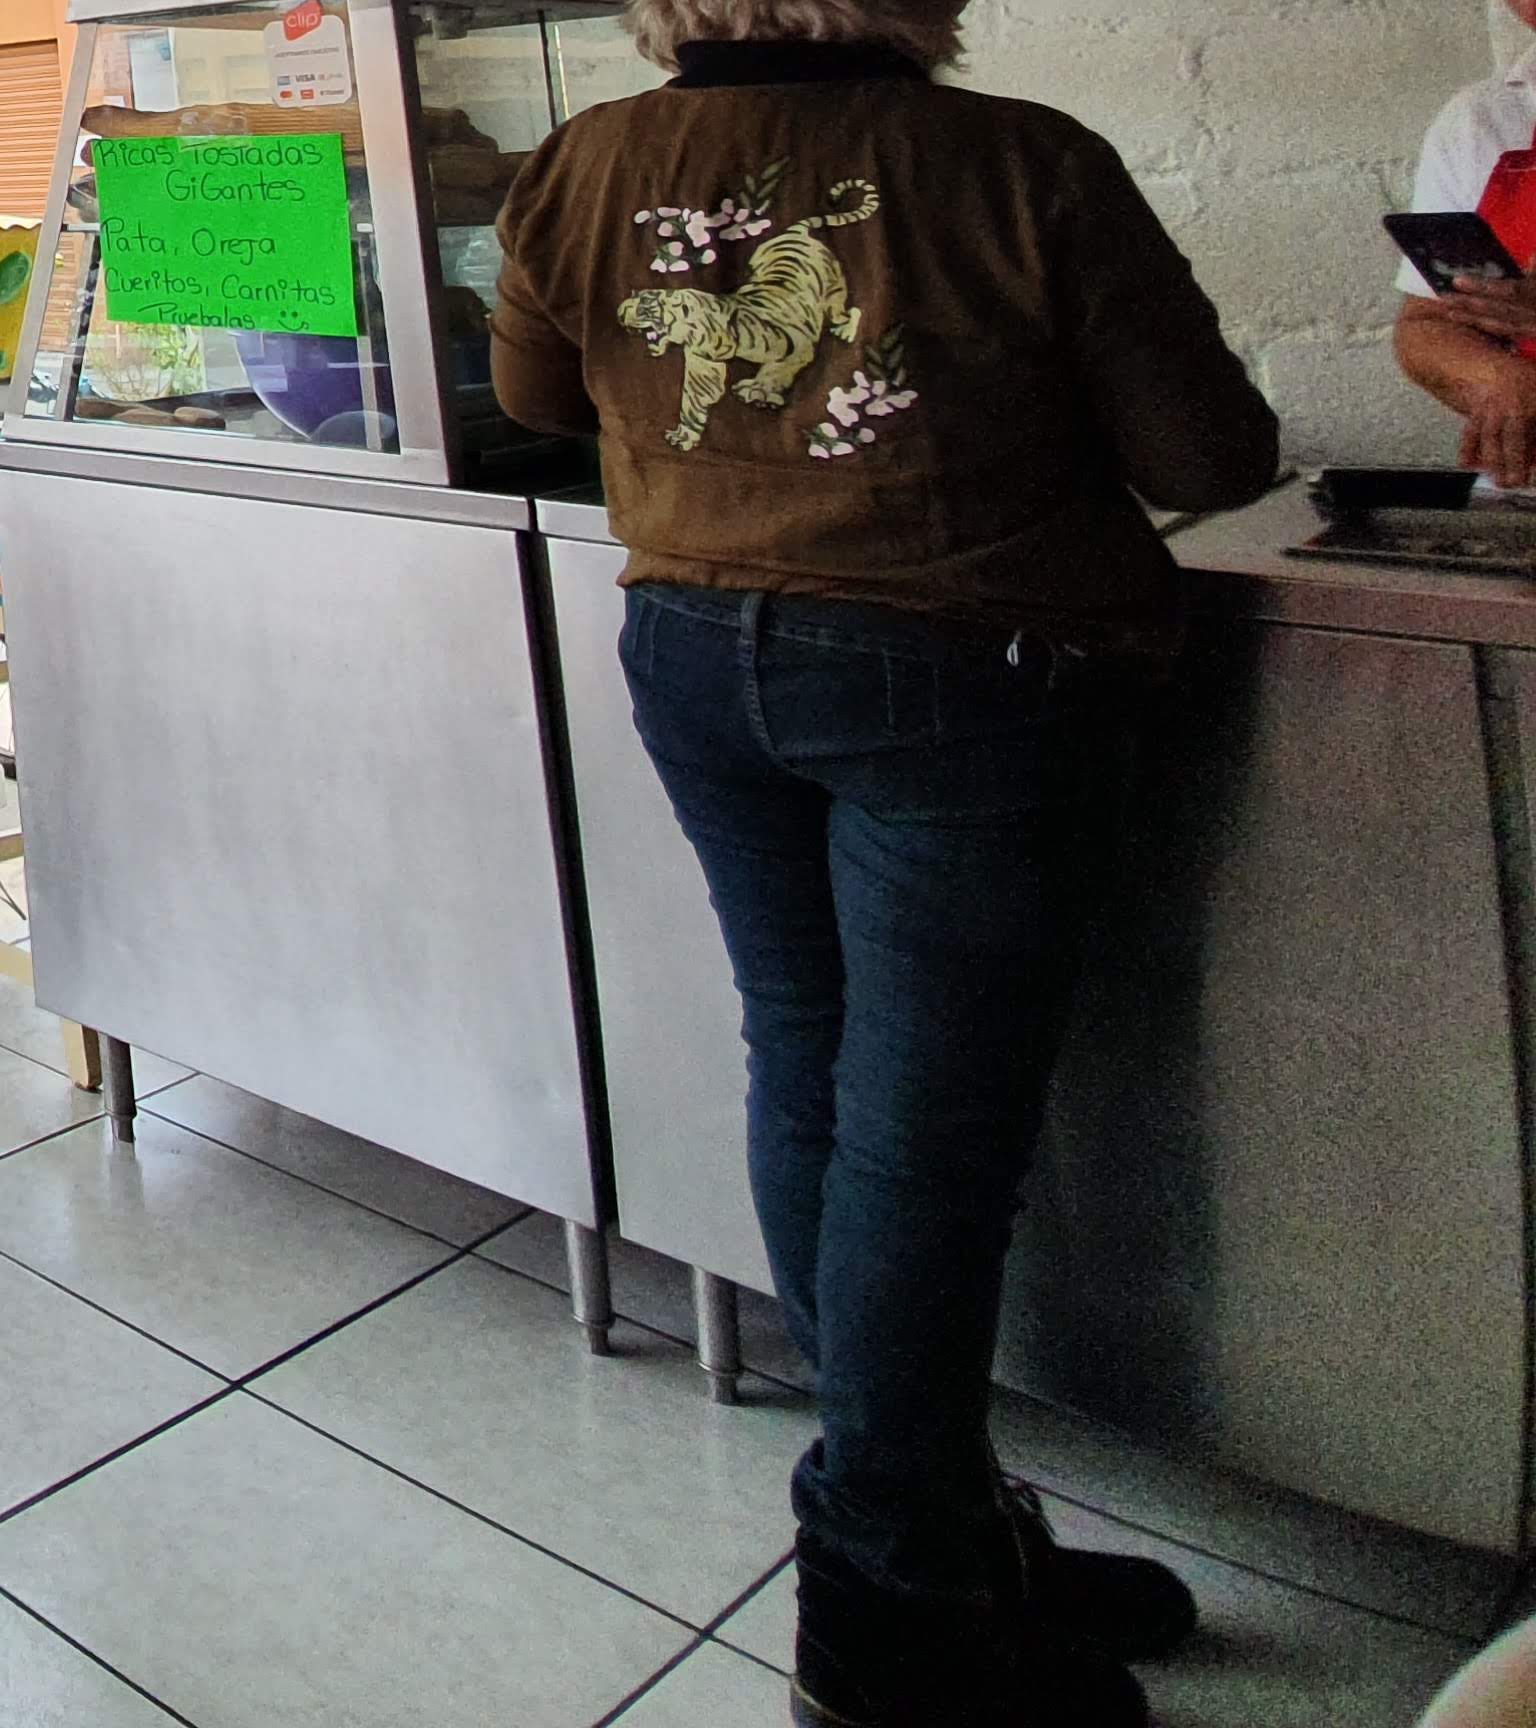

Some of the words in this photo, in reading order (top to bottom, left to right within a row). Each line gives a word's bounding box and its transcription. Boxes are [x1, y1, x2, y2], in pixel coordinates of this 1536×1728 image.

[286, 12, 318, 29] clip
[94, 139, 175, 167] Ricas
[221, 274, 336, 306] Carnitas
